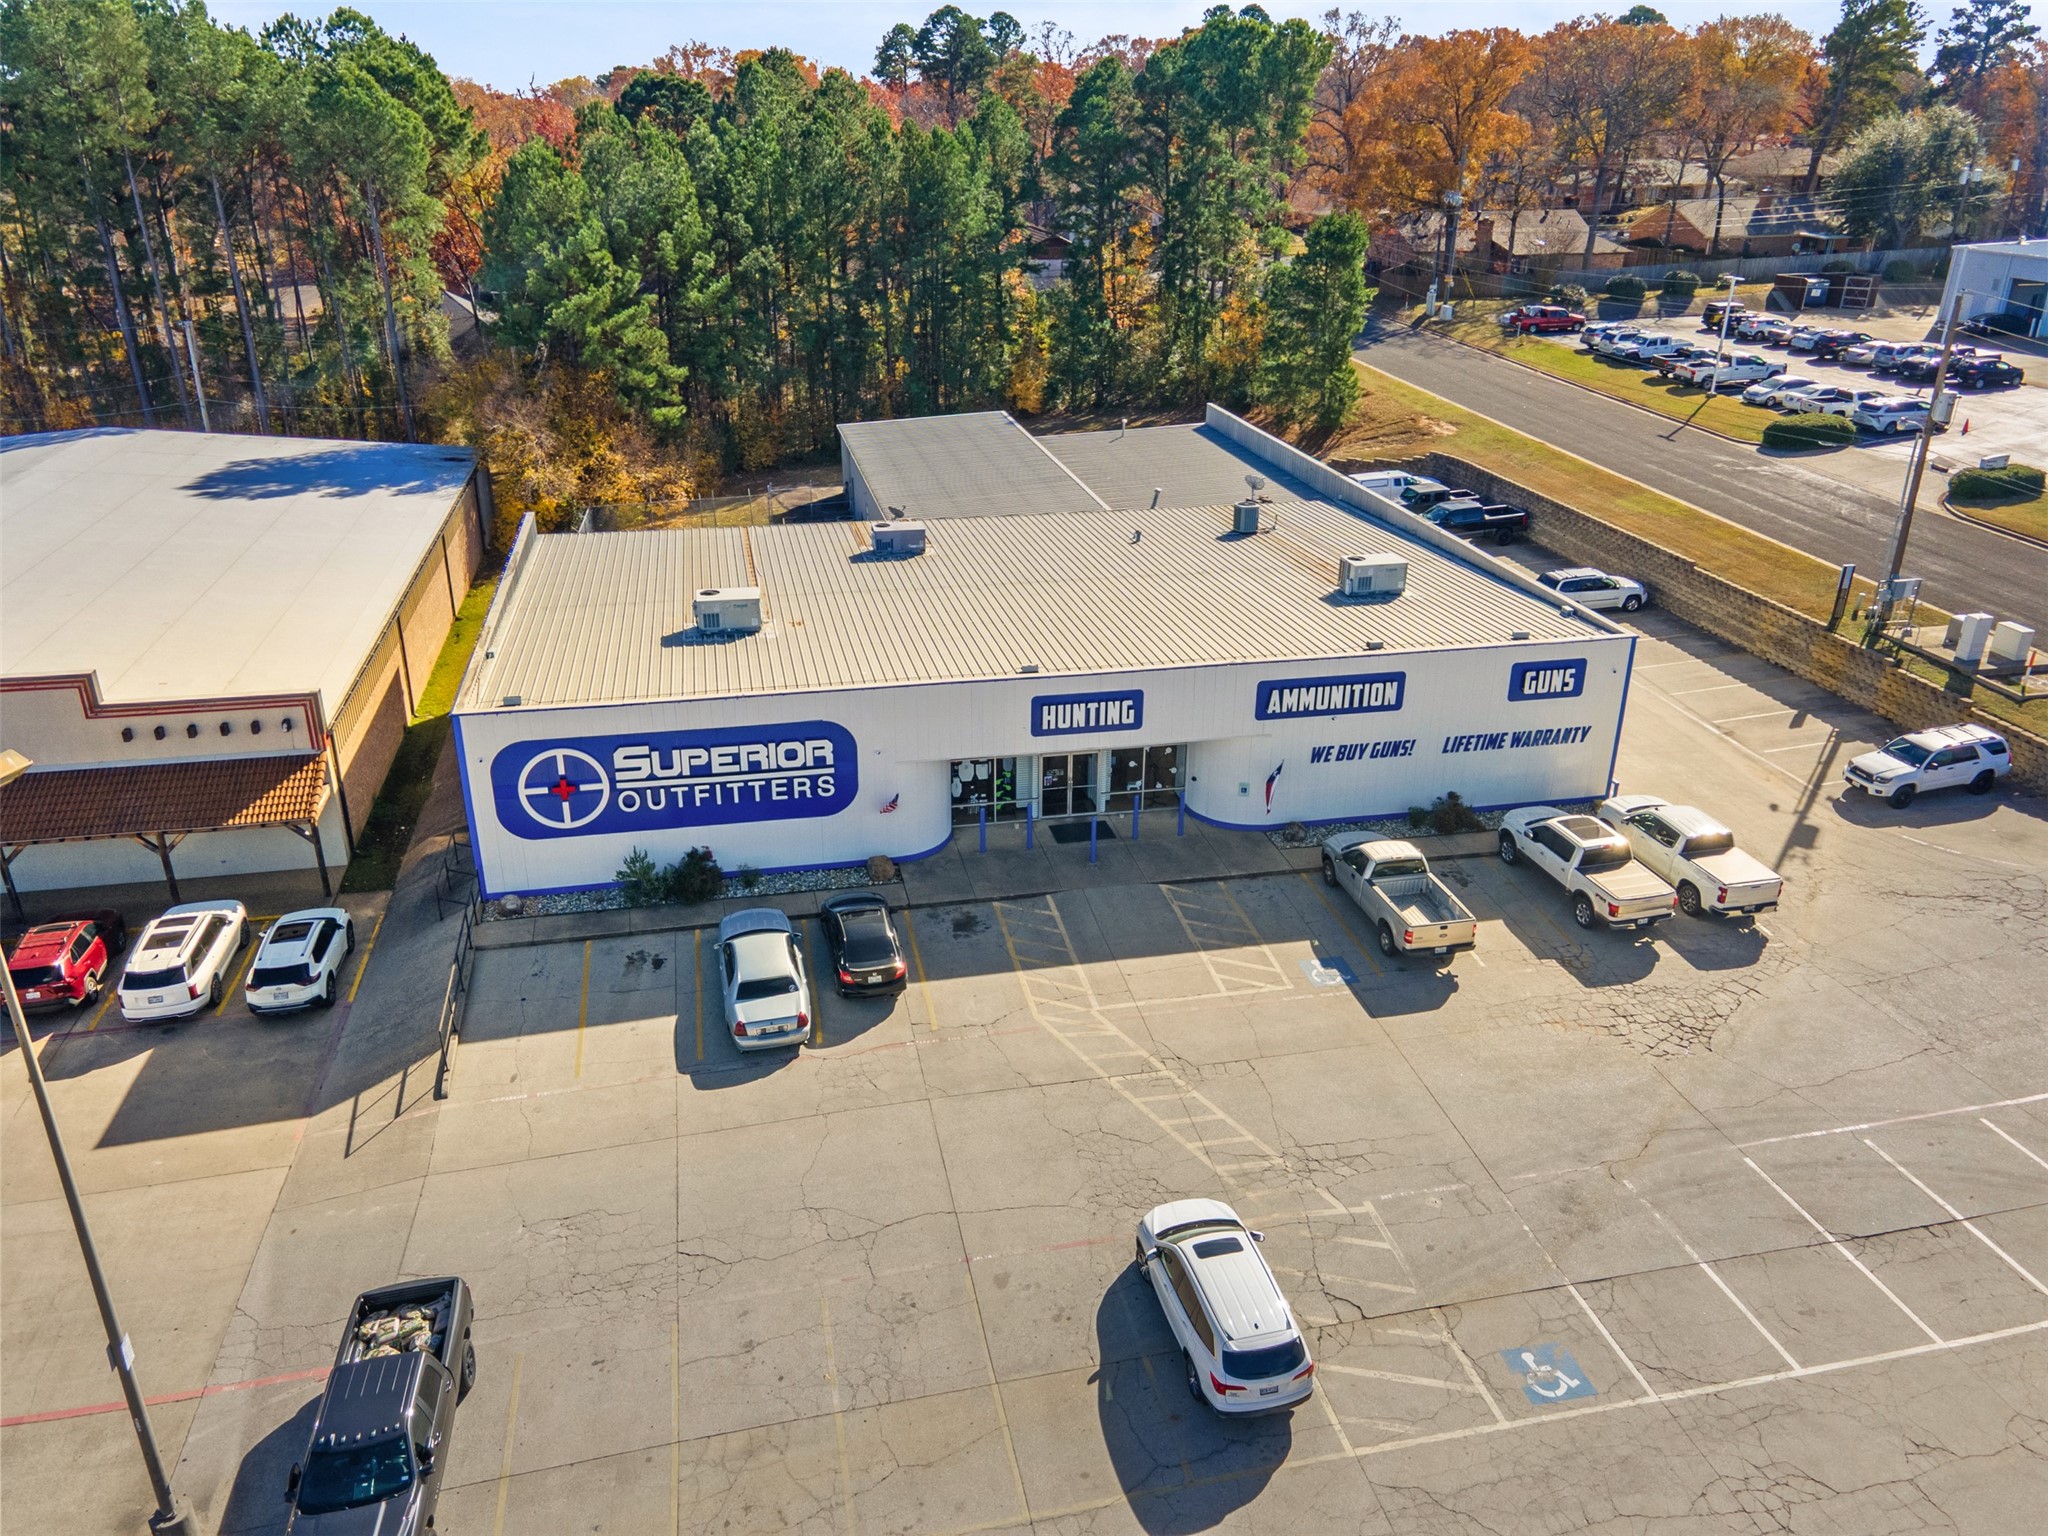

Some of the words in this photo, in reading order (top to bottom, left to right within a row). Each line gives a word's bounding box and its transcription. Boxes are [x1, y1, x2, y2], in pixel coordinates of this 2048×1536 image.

[1523, 668, 1575, 694] GUNS
[1266, 681, 1397, 713] AMMUNITION
[1041, 700, 1135, 730] HUNTING
[1310, 746, 1333, 763] WE
[1335, 743, 1368, 761] BUY
[1370, 739, 1415, 759] GUNS!
[1442, 732, 1507, 753] LIFETIME
[1510, 726, 1591, 747] WARRANTY
[613, 739, 833, 780] SUPERIOR
[617, 777, 835, 812] OUTFITTERS
